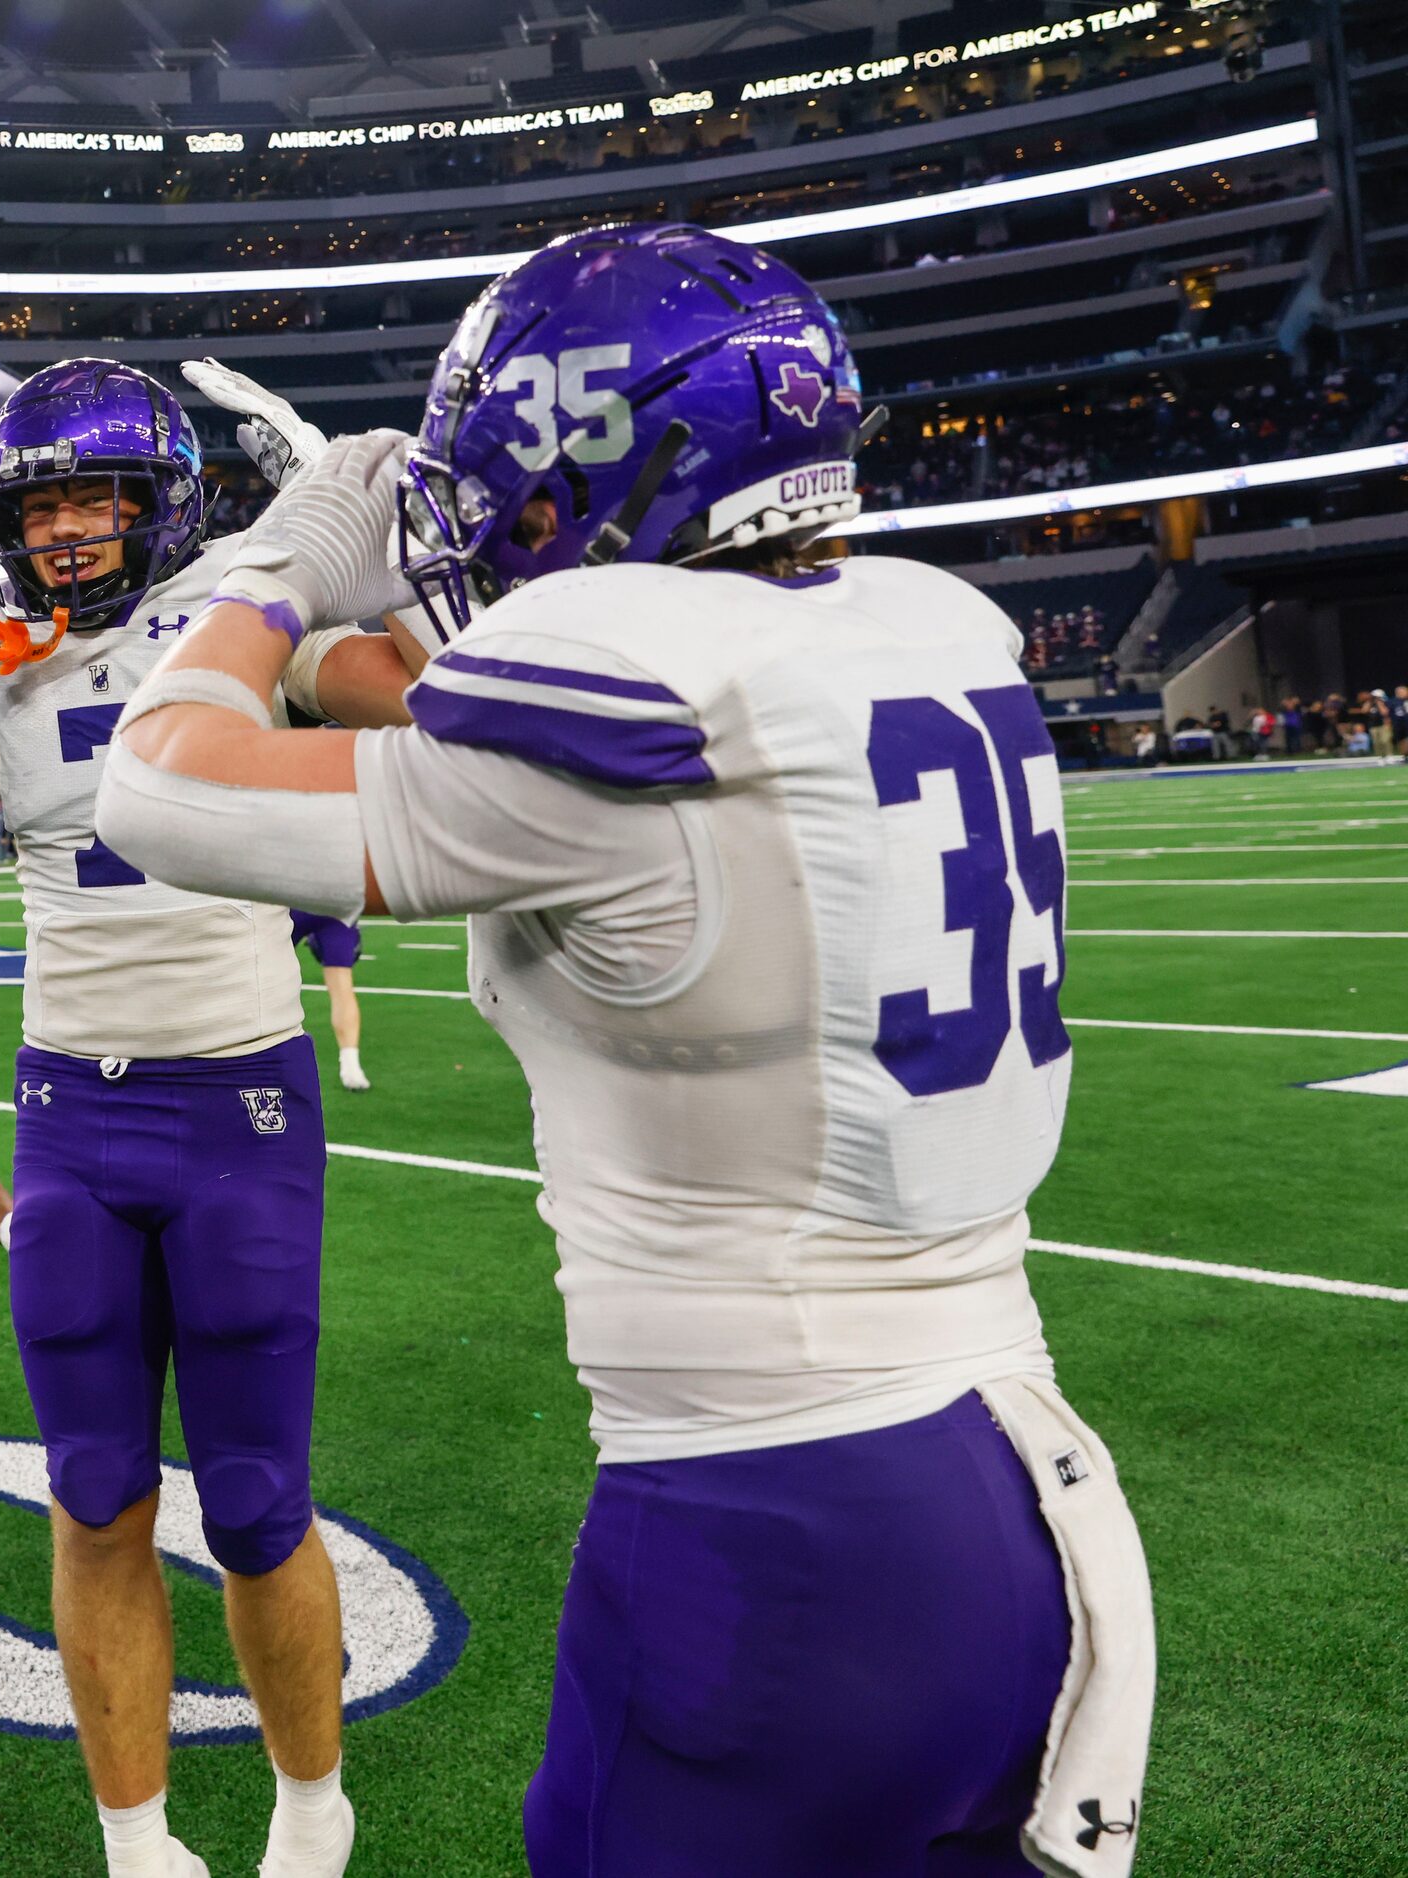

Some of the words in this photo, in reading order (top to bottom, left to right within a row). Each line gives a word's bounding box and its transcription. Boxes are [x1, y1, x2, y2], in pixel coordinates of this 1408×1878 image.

[741, 67, 853, 100] AMERICA'S
[857, 57, 909, 81] CHIP
[914, 46, 957, 69] FOR
[962, 19, 1084, 60] AMERICA'S
[1087, 2, 1156, 32] TEAM
[15, 132, 110, 150] AMERICA'S
[112, 135, 163, 151] TEAM
[268, 128, 366, 148] AMERICA'S
[369, 125, 415, 143] CHIP
[419, 122, 456, 139] FOR
[460, 110, 563, 136] AMERICA'S
[566, 103, 623, 124] TEAM
[496, 343, 635, 473] 35
[867, 683, 1072, 1097] 35
